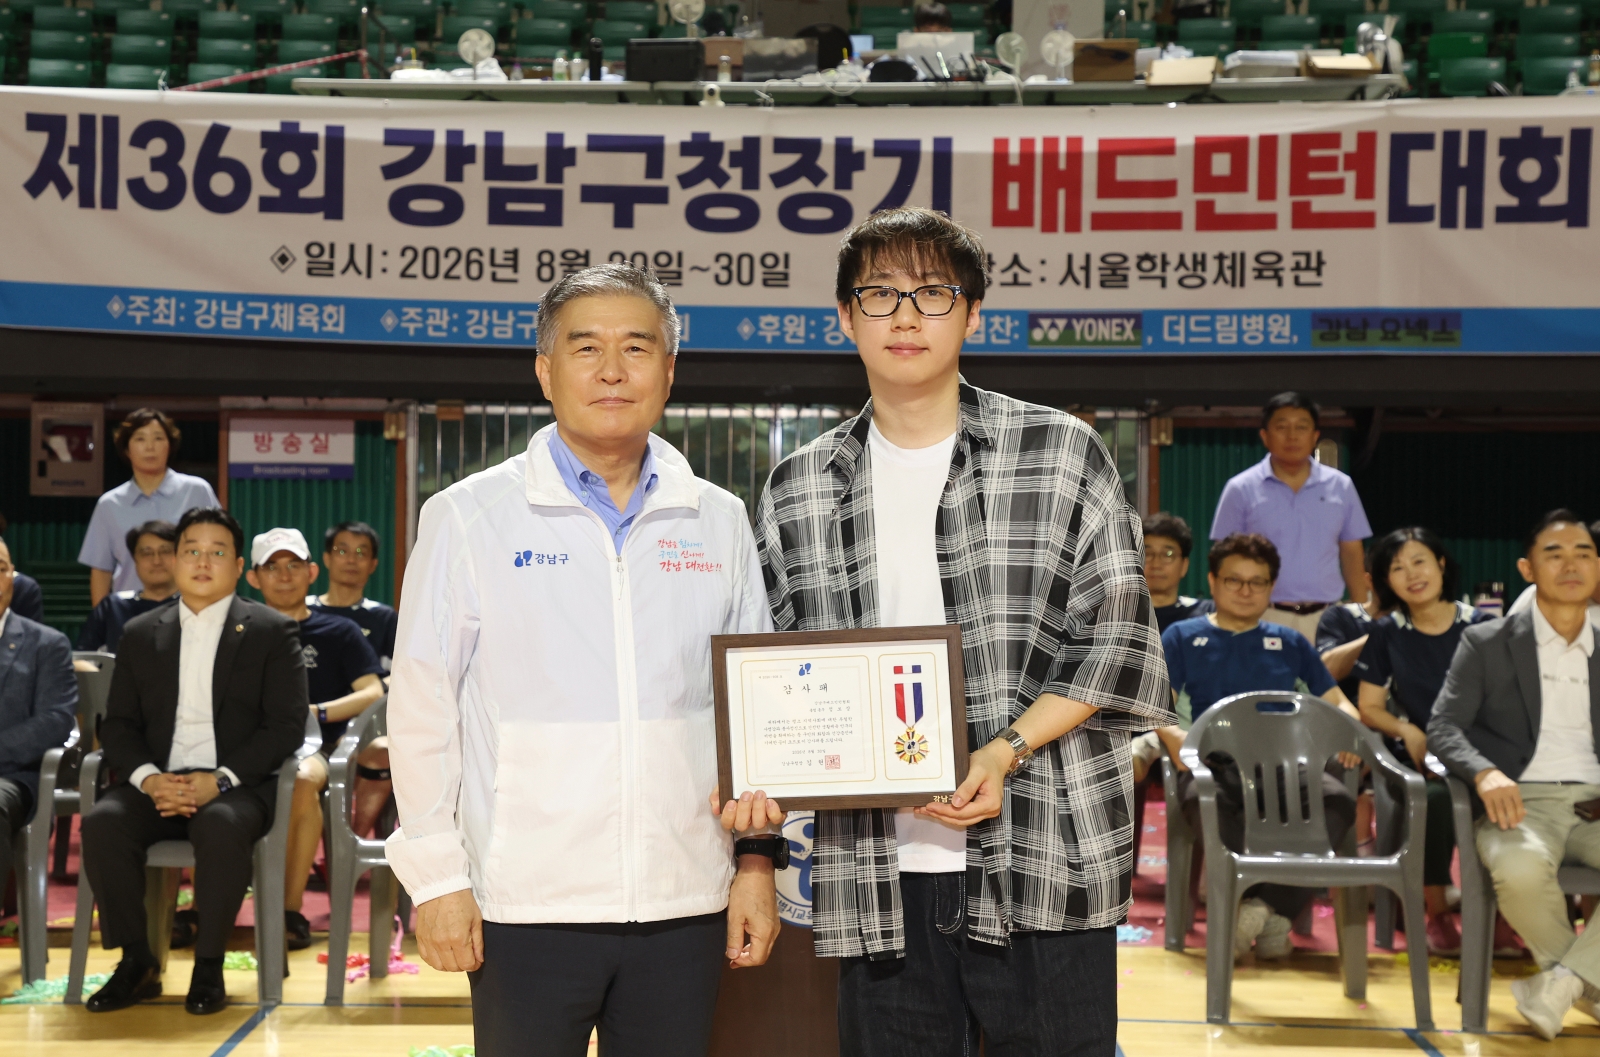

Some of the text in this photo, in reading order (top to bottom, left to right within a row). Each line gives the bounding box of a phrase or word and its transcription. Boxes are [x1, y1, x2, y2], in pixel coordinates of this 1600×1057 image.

[22, 112, 345, 220] 제36회
[380, 128, 953, 234] 강남구청장기
[1058, 250, 1327, 289] 서울학생체육관
[194, 298, 346, 334] 강남구체육회
[1070, 317, 1137, 342] YONEX
[1317, 316, 1370, 343] 강남
[1379, 316, 1458, 343] 요넥스
[534, 553, 570, 565] 강남구
[659, 560, 682, 573] 강남
